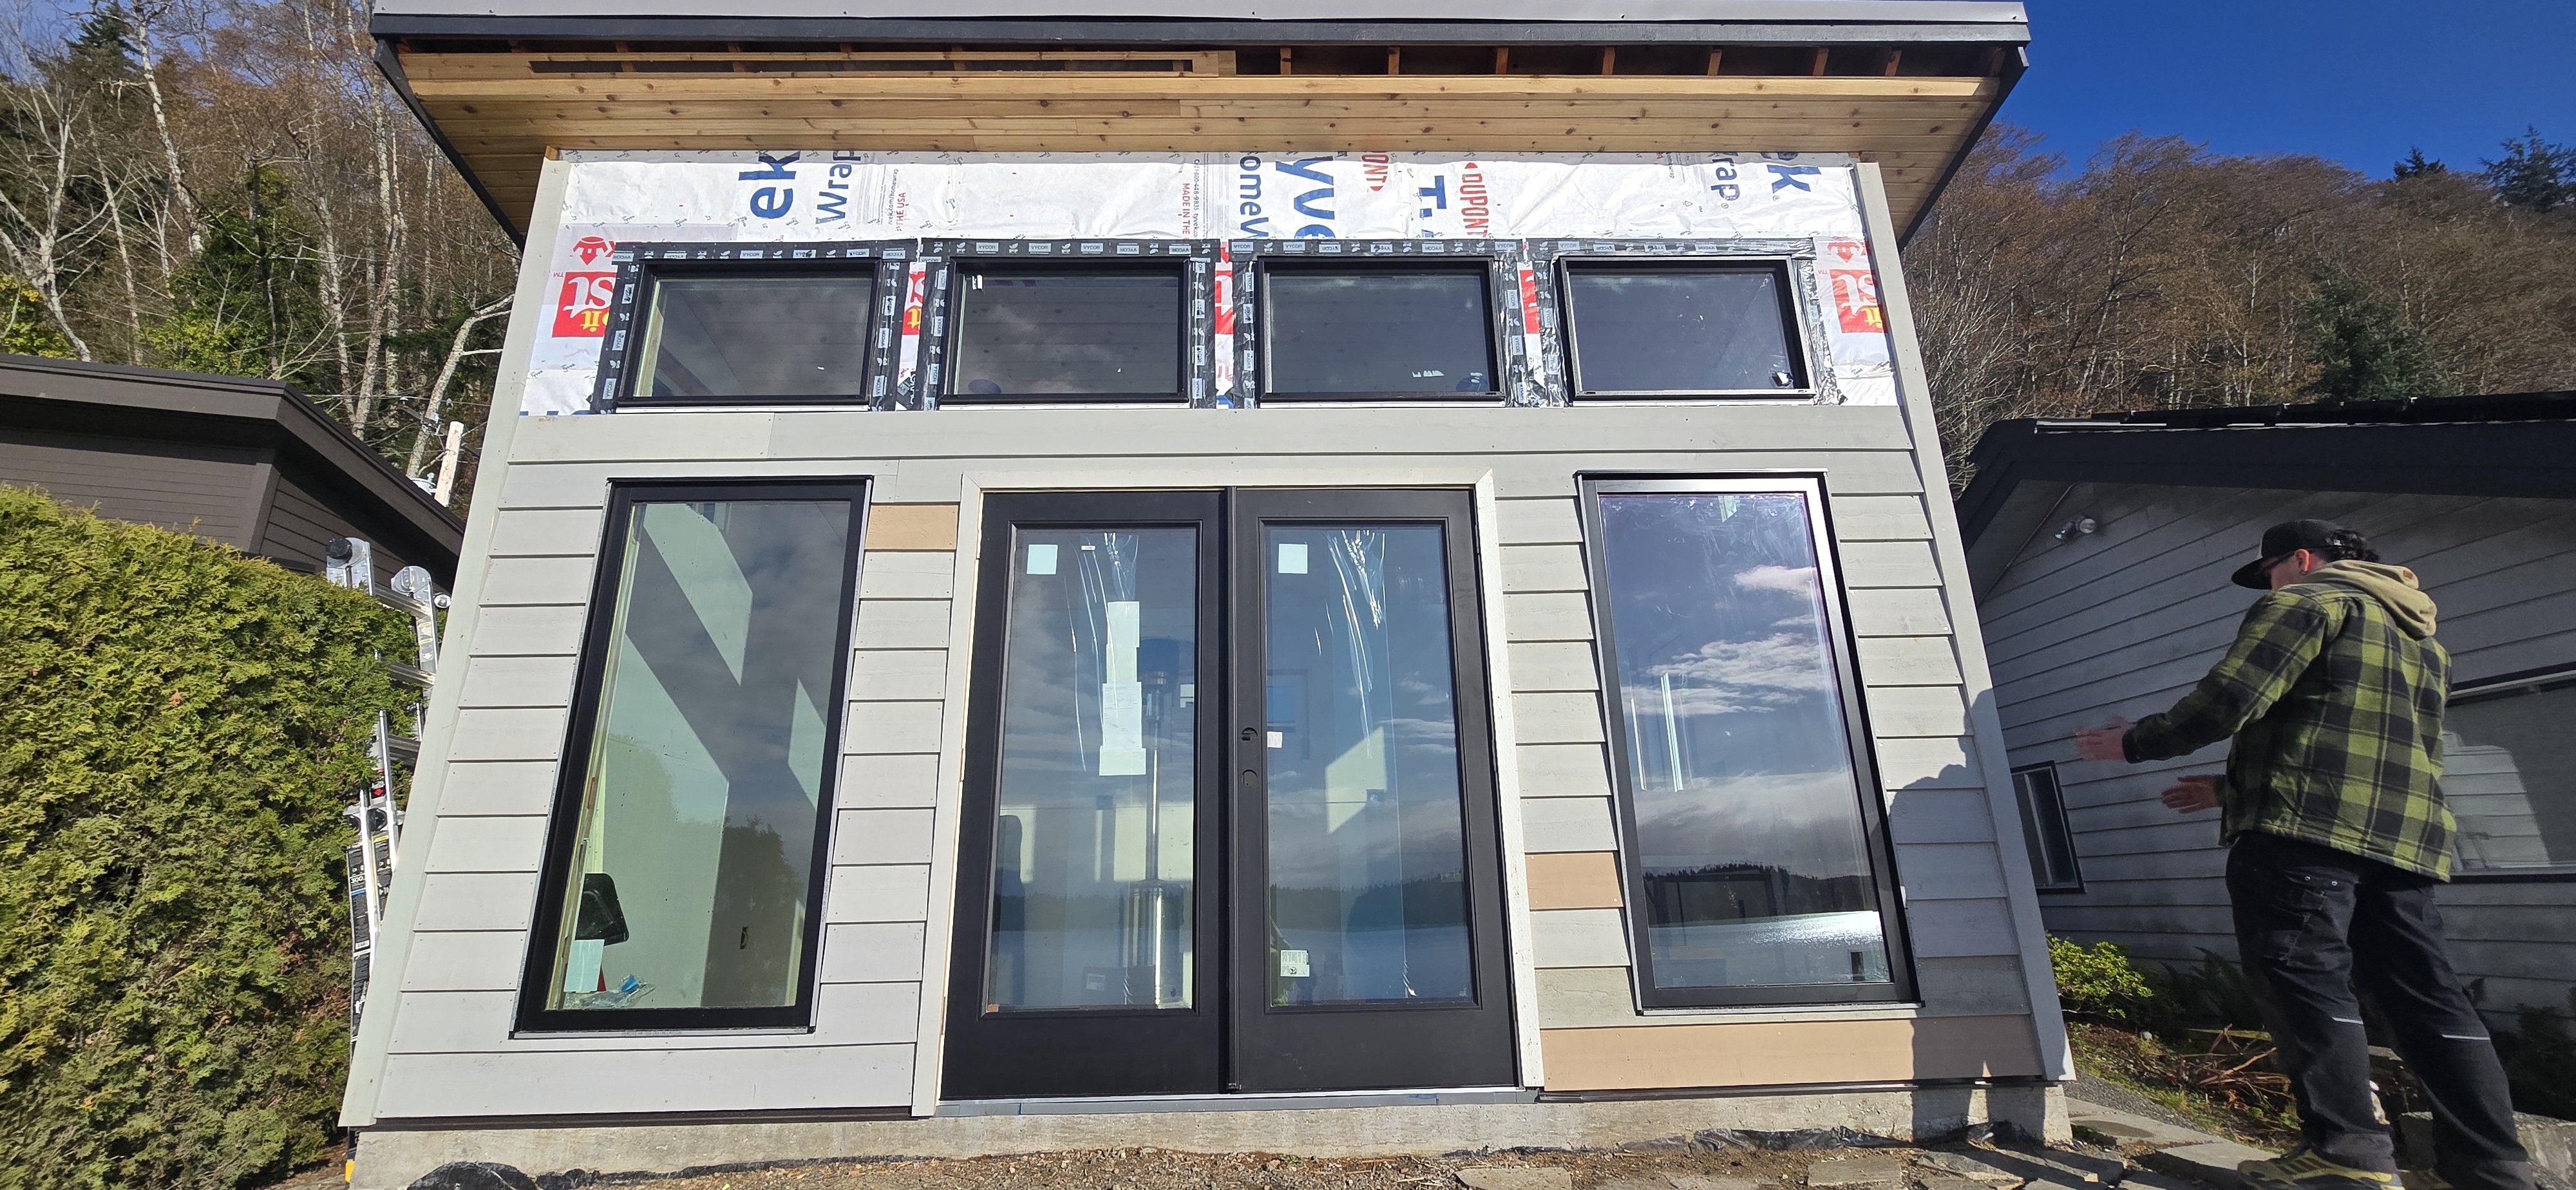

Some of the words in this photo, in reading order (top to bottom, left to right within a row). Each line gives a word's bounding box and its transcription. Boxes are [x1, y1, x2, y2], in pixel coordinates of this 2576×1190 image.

[1361, 153, 1389, 184] ONT
[896, 192, 906, 208] USA
[1460, 173, 1489, 238] DUPONT
[1182, 209, 1190, 218] IN
[579, 310, 603, 332] it
